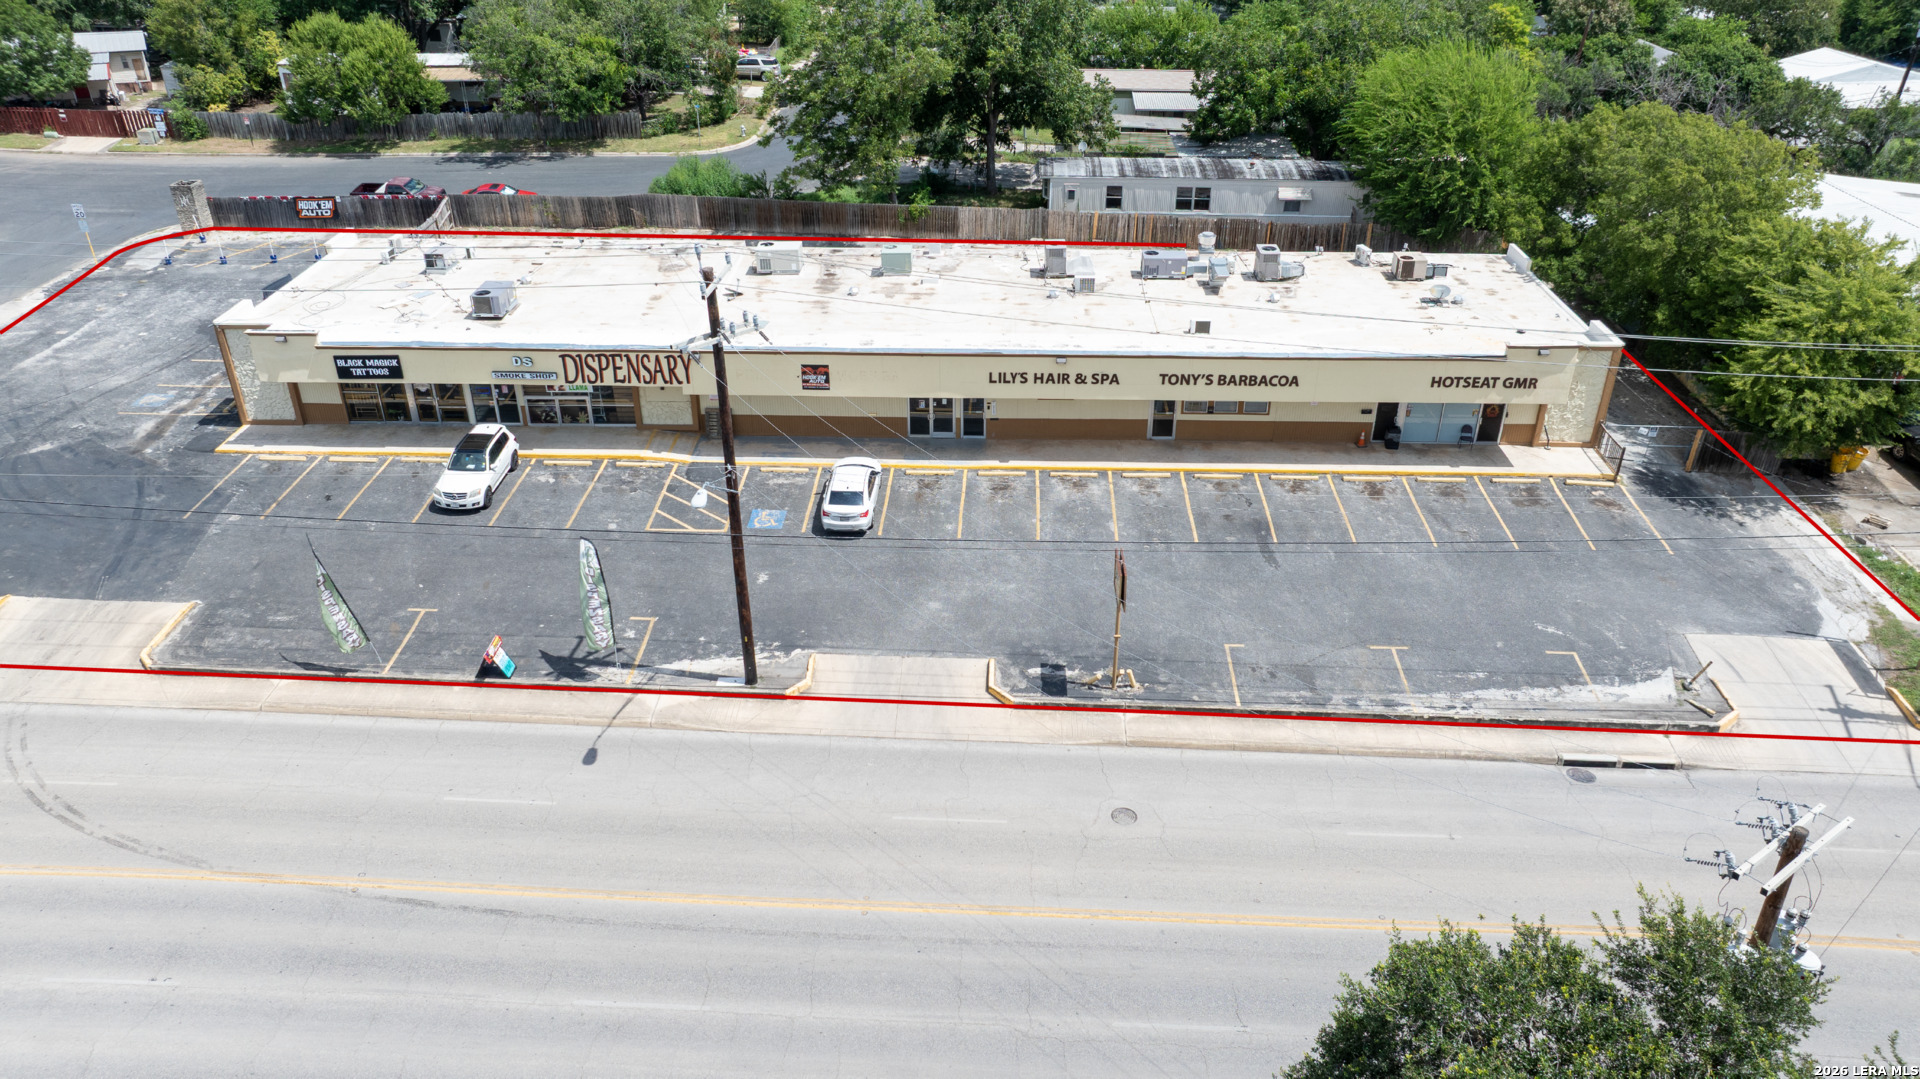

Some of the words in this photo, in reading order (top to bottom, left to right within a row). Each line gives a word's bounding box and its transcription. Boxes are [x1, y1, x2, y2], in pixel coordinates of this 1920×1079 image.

[298, 200, 318, 210] HOOK
[319, 200, 333, 210] 'EM
[336, 359, 364, 367] BLACK
[365, 359, 399, 367] MAGICK
[511, 356, 533, 367] DS
[350, 368, 389, 376] TATTOOS
[559, 353, 691, 385] DISPENSARY
[989, 372, 1028, 384] LILY'S
[1033, 372, 1071, 384] HAIR
[1074, 373, 1088, 384] &
[1091, 373, 1120, 385] SPA
[1159, 373, 1214, 386] TONY'S
[1217, 374, 1299, 387] BARBACOA
[1430, 376, 1500, 388] HOTSEAT
[1502, 377, 1538, 389] GMR
